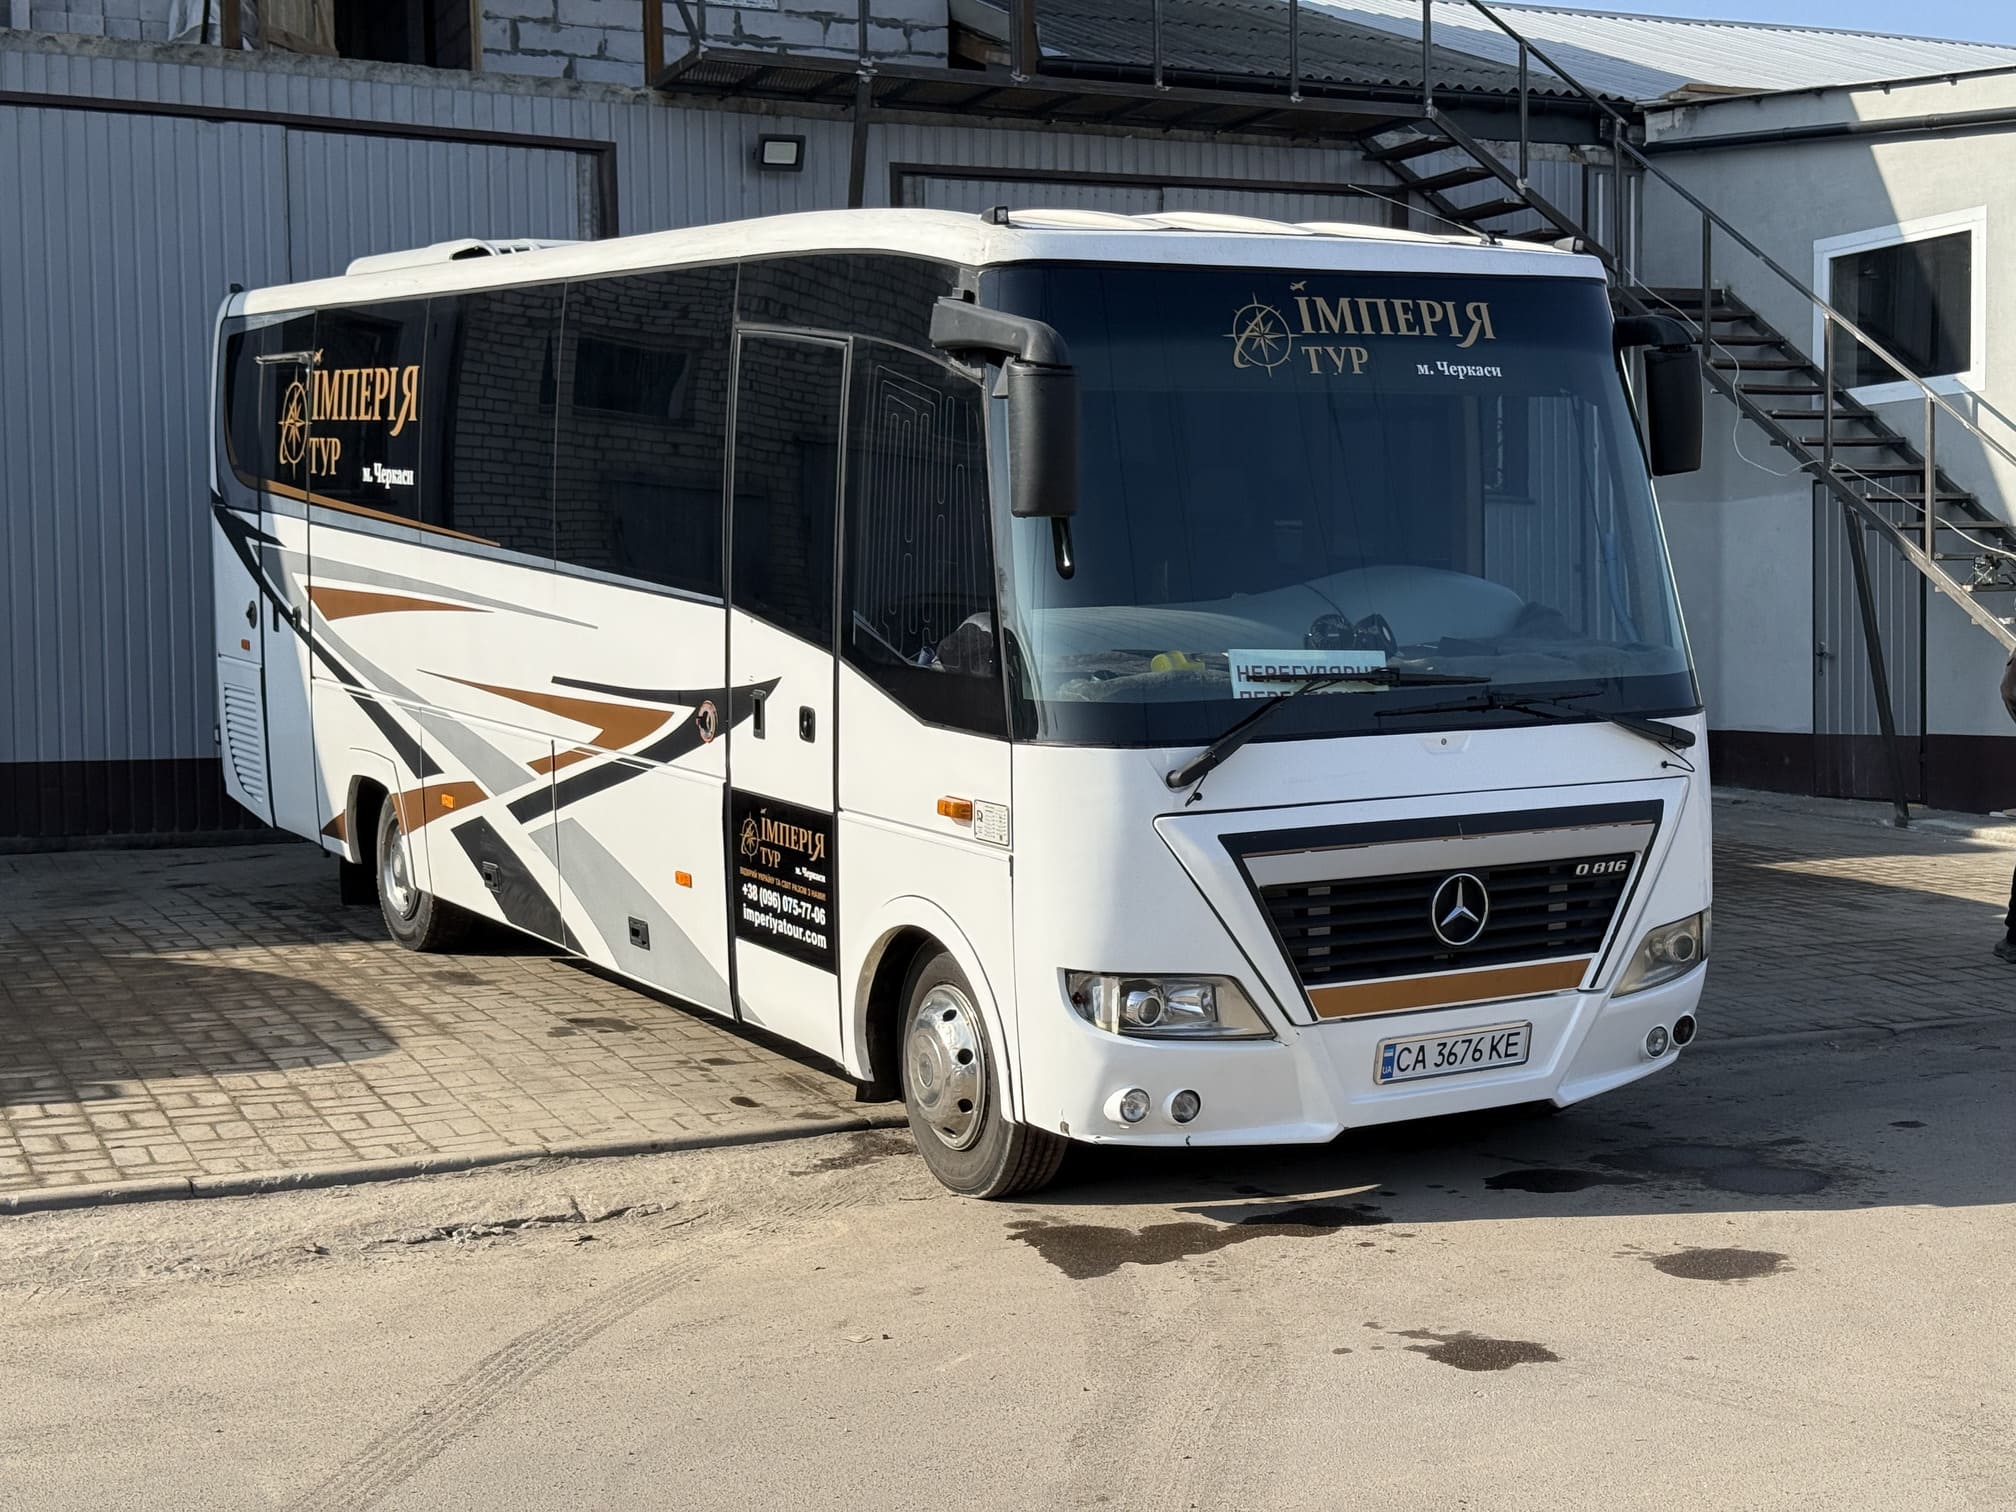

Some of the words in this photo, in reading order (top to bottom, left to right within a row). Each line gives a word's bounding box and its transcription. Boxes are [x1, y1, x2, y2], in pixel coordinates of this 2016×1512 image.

[1301, 346, 1369, 376] ТУР
[1416, 364, 1434, 375] м.
[1436, 361, 1503, 379] Черкаси
[309, 437, 341, 477] ТУР
[362, 467, 373, 482] м.
[373, 462, 415, 489] Черкаси
[760, 847, 781, 868] ТУР
[1592, 860, 1628, 874] 816
[742, 882, 758, 901] +38
[759, 887, 781, 913] (096)
[782, 895, 826, 925] 075-77-06
[743, 903, 828, 949] imperiyatour.com
[1396, 1045, 1426, 1073] CA
[1433, 1036, 1485, 1069] 3676
[1488, 1032, 1521, 1061] KE
